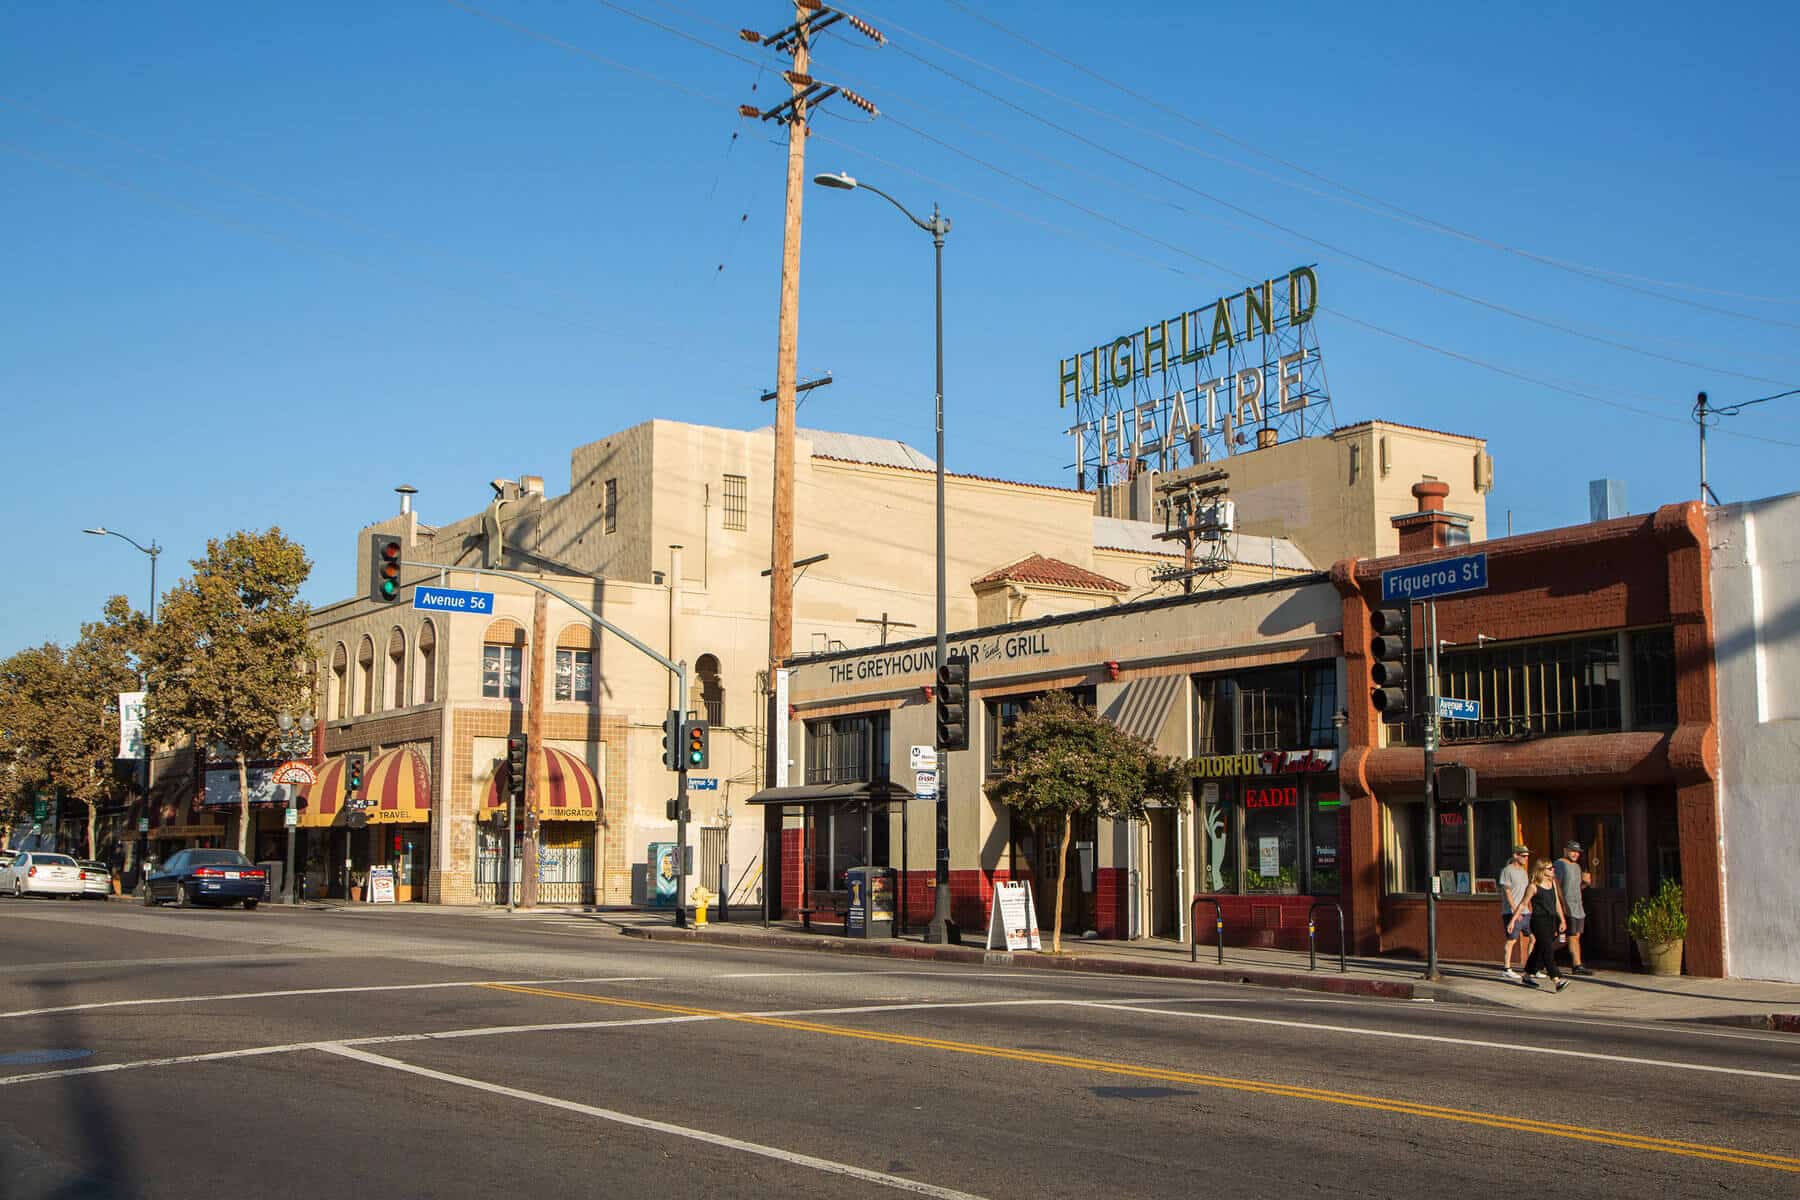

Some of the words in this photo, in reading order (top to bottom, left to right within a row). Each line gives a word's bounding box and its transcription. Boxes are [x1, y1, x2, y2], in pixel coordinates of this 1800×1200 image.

[1059, 266, 1319, 408] HIGHLAND
[1067, 348, 1309, 474] THEATRE
[1389, 569, 1457, 596] Figueroa
[1462, 561, 1480, 581] St
[422, 592, 465, 608] Avenue
[470, 596, 486, 609] 56
[829, 665, 853, 683] THE
[857, 650, 938, 679] GREYHOUN
[1006, 634, 1050, 658] GRILL
[1465, 701, 1474, 713] 56
[1188, 753, 1261, 778] OLORFUL
[380, 810, 410, 820] TRAVEL
[547, 807, 594, 817] IMMIGRATION
